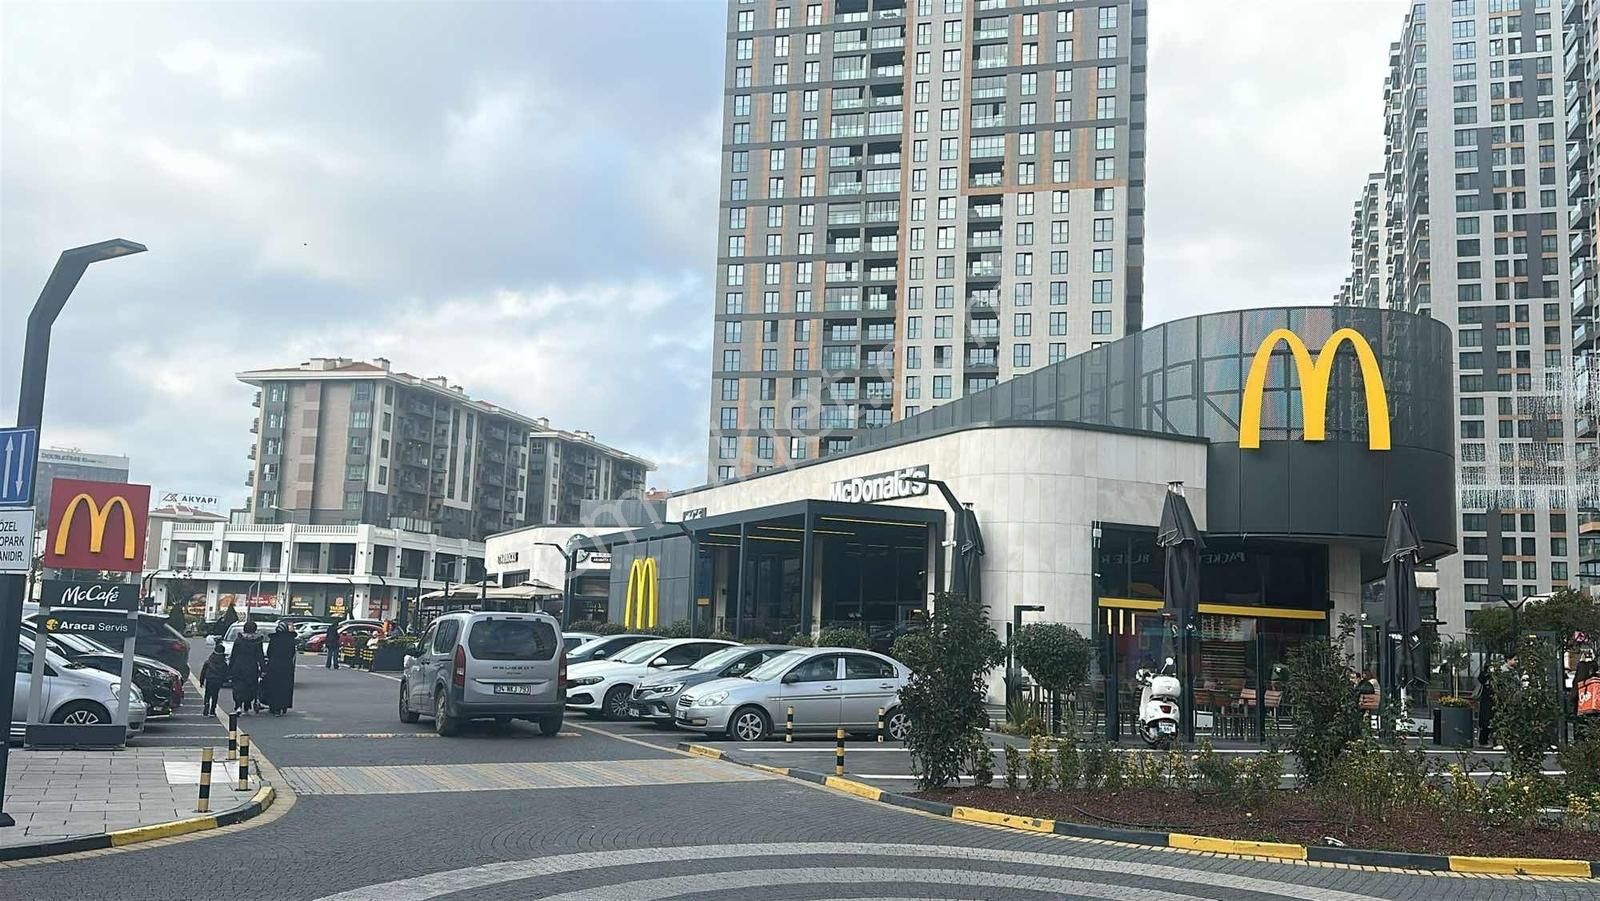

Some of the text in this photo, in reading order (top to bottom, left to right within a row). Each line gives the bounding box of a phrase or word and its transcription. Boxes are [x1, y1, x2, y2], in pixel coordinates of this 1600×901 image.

[830, 468, 927, 503] McDonald's
[181, 495, 217, 504] AKYAPI
[61, 585, 119, 607] McCafé
[60, 621, 128, 632] Araca Servis
